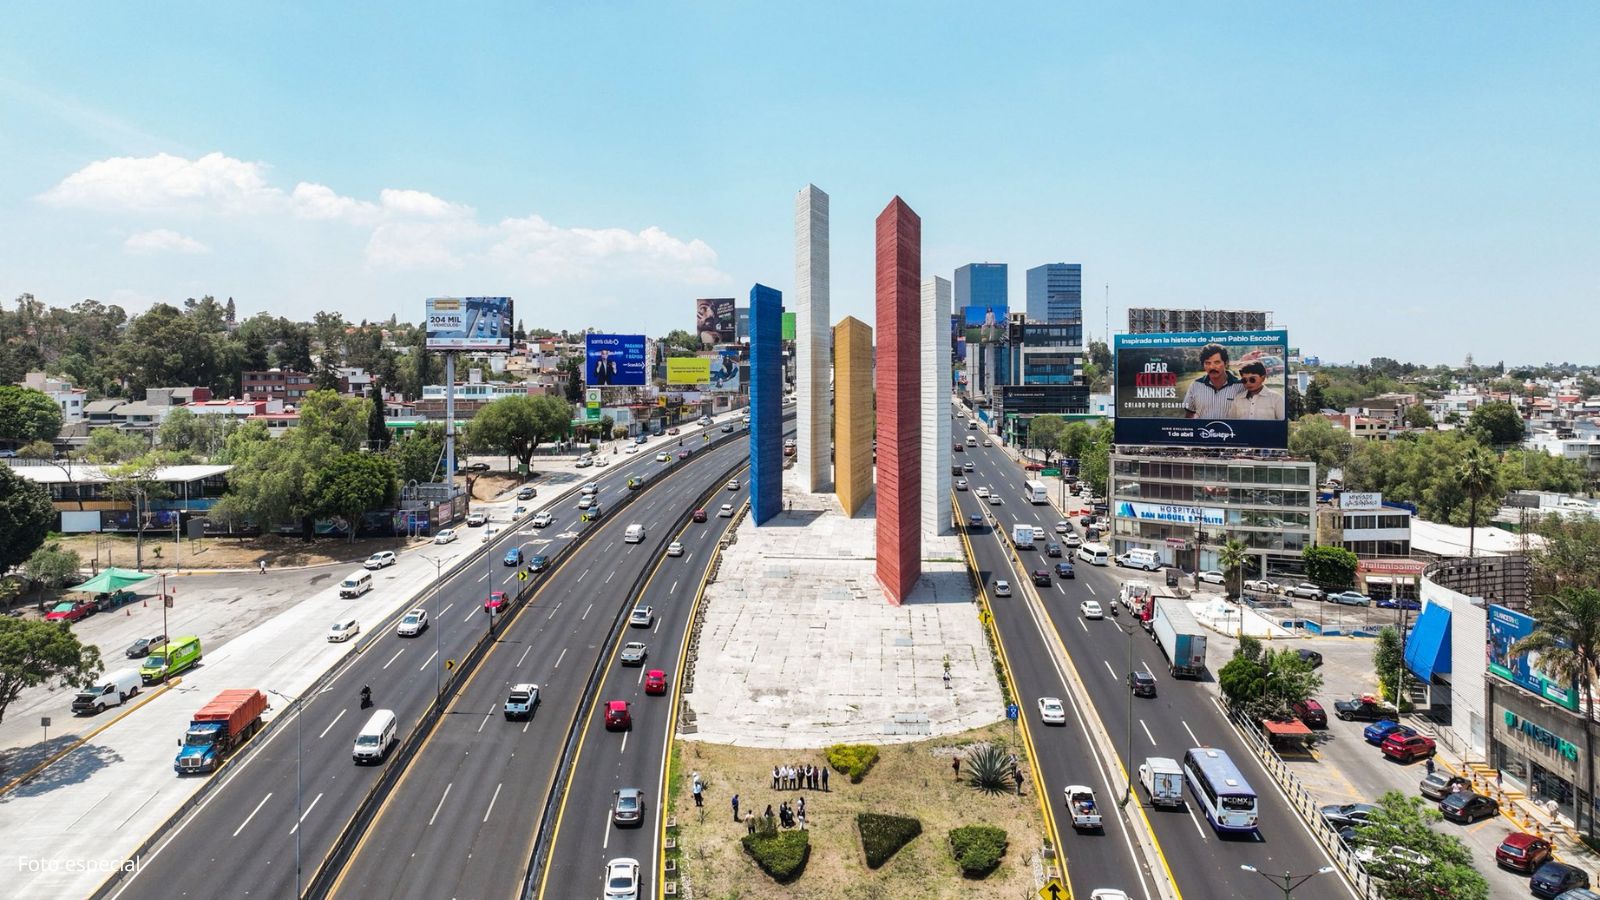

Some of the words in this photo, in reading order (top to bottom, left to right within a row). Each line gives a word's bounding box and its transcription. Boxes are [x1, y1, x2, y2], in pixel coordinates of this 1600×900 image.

[1121, 337, 1152, 346] Inspirada
[1144, 363, 1168, 373] DEAR
[1135, 373, 1177, 387] KILLER
[1137, 387, 1176, 399] NANNIES
[1160, 505, 1201, 514] HOSPITAL
[1157, 513, 1186, 522] MIGUEL
